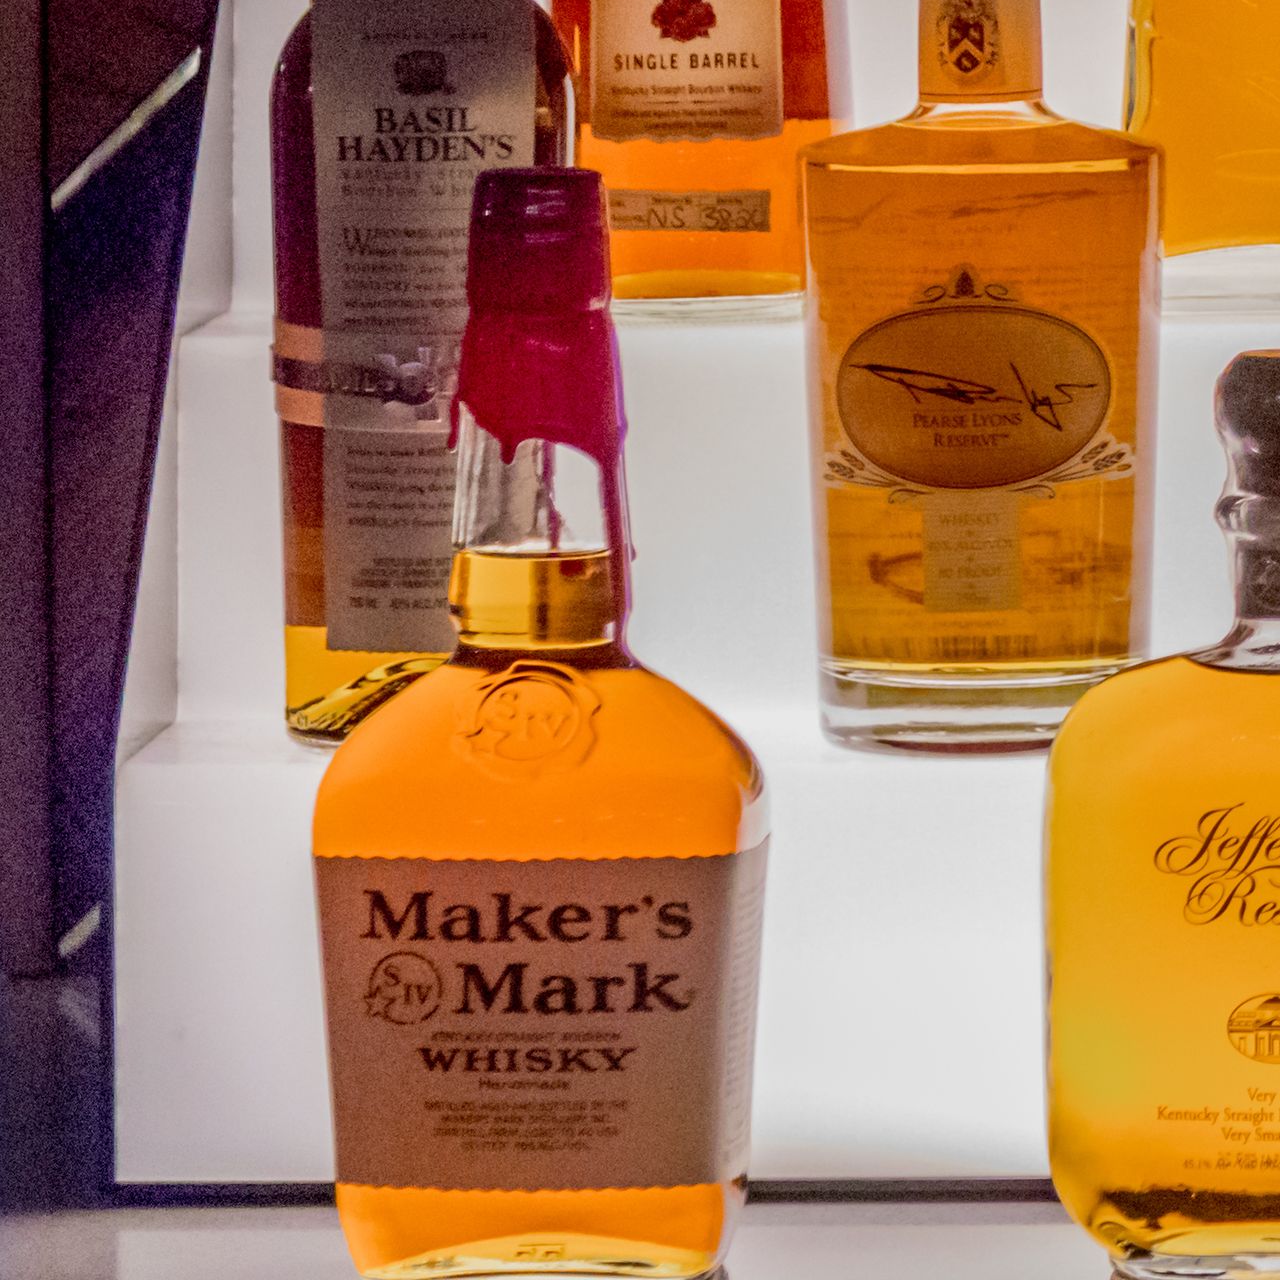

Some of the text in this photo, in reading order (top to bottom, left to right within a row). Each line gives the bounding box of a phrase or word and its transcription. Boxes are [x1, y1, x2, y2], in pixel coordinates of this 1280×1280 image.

[613, 52, 761, 72] SINGLE BARREL
[375, 107, 477, 133] BASIL
[336, 134, 515, 162] HAYDEN'S
[913, 411, 1023, 429] PEARSE LYONS
[360, 889, 694, 945] Maker's
[455, 962, 693, 1015] Mark
[417, 1046, 639, 1072] WHISKY
[1247, 1087, 1277, 1103] Very
[1156, 1106, 1220, 1126] Kentucky
[1223, 1106, 1275, 1126] Straight
[1221, 1127, 1251, 1143] Very
